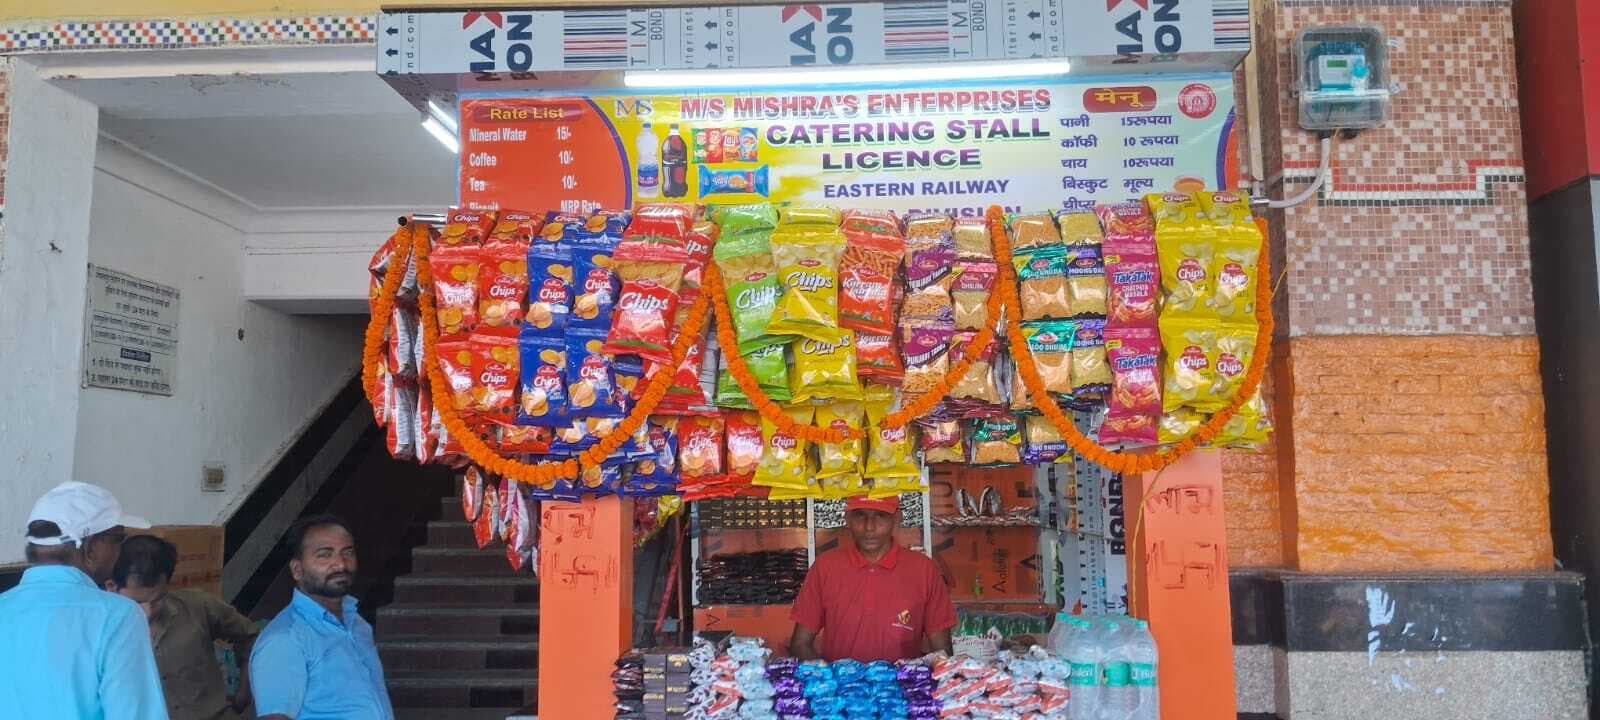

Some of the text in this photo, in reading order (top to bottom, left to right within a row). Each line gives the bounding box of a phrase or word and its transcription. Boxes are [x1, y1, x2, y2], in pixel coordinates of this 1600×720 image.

[972, 2, 984, 32] BOND
[651, 10, 663, 41] BOND
[681, 88, 1051, 119] M/S MISHRA'S ENTERPRISES
[1095, 88, 1145, 107] मेनू
[490, 107, 565, 121] Rate List
[1060, 114, 1090, 128] पानी
[469, 128, 528, 142] Mineral Water
[556, 127, 572, 140] 15/-
[767, 118, 1050, 145] CATERING STALL
[1060, 134, 1098, 149] कॉफी
[1123, 138, 1136, 147] 10
[469, 153, 497, 166] Coffee
[559, 152, 574, 165] 10/-
[822, 149, 982, 169] LICENCE
[1061, 159, 1088, 169] चाय
[469, 178, 487, 191] Tea
[562, 176, 578, 189] 10/-
[825, 179, 1009, 198] EASTERN RAILWAY
[1063, 176, 1109, 192] बिस्कुट
[1123, 178, 1154, 192] मूल्य
[561, 200, 602, 213] MRP Rate
[908, 206, 1021, 217] DIVISIN
[786, 271, 833, 293] Chips
[1178, 269, 1205, 282] Chips
[584, 279, 611, 290] Chips
[490, 286, 516, 298] Chips
[539, 288, 566, 299] Chips
[619, 293, 670, 312] Chips
[580, 366, 607, 378] Chips
[1217, 361, 1243, 375] Chips
[481, 371, 508, 385] Chips
[534, 375, 561, 388] Chips
[881, 429, 905, 440] Chips
[771, 437, 796, 449] Chips
